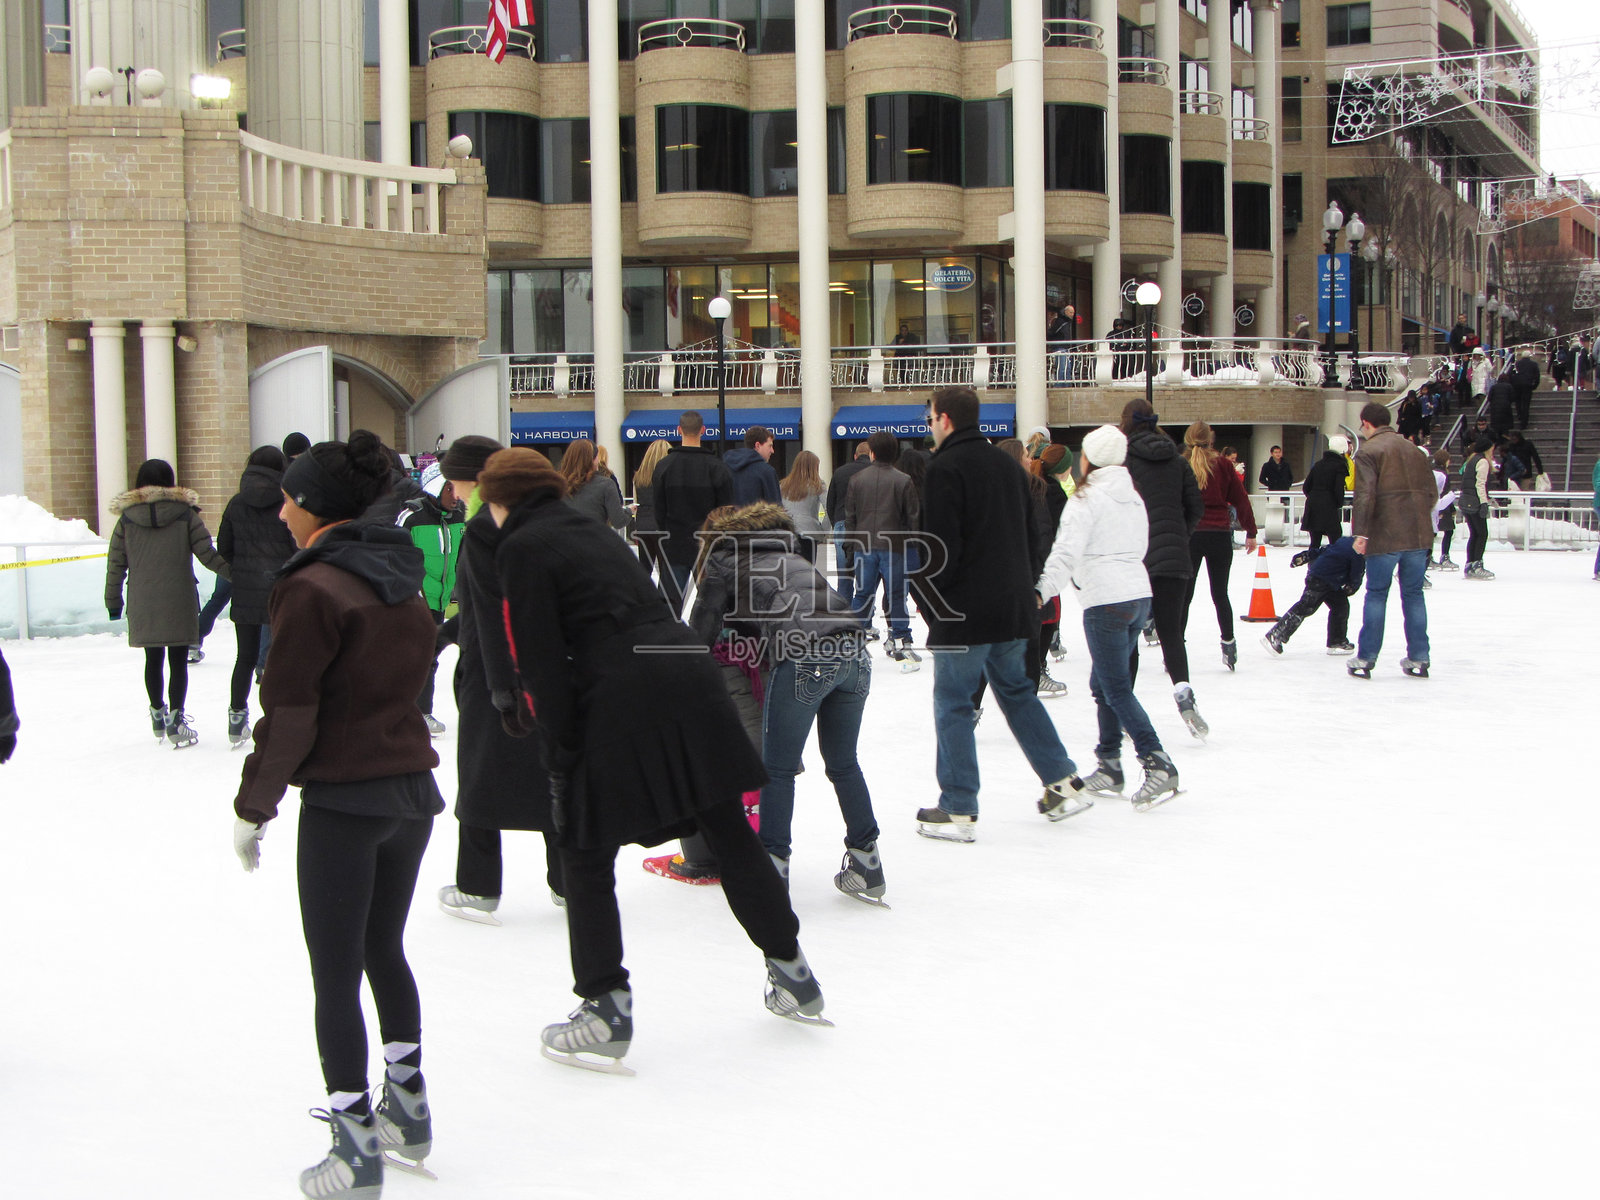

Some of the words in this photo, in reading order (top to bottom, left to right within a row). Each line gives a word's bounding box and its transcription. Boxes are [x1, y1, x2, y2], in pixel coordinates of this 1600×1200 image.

[934, 269, 971, 277] GELATERIA
[524, 431, 589, 440] HARBOUR
[638, 428, 721, 437] WASHION
[729, 427, 794, 436] HAOUR
